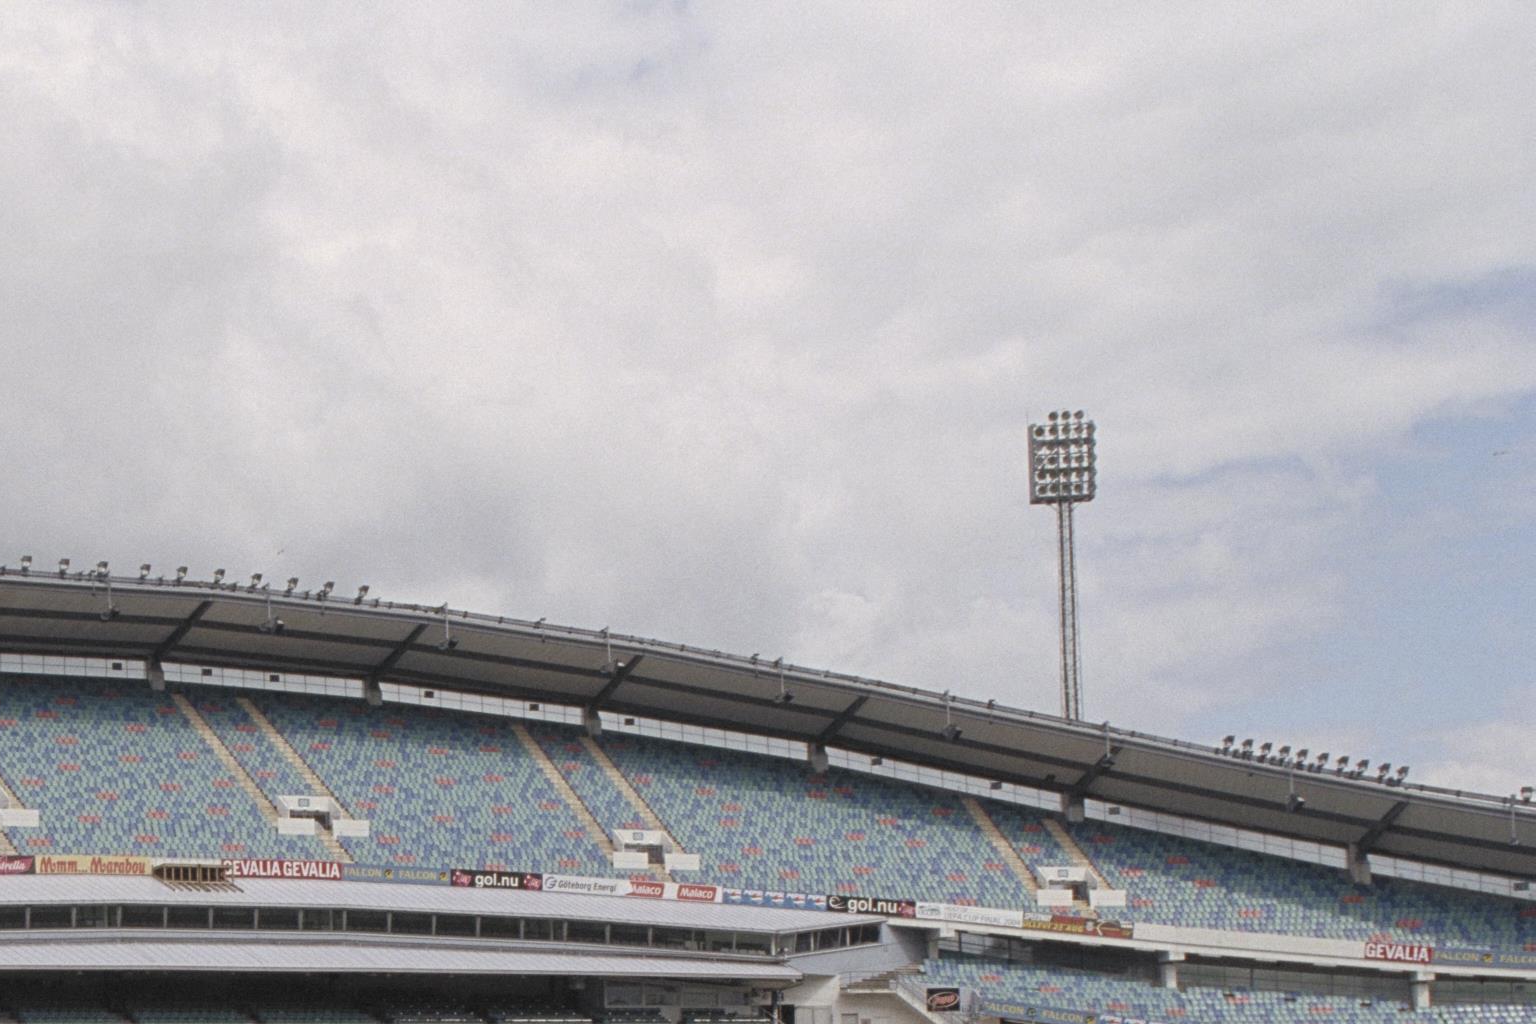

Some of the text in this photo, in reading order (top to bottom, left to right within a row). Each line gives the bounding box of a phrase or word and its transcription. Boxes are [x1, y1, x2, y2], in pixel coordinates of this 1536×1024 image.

[40, 857, 146, 874] Mmm... Marabou
[224, 860, 340, 878] GEVALIA GEVALIA
[475, 873, 519, 888] gol.nu
[680, 887, 714, 898] Malaco
[848, 897, 898, 914] gol.nu
[1366, 943, 1430, 962] GEVALIA
